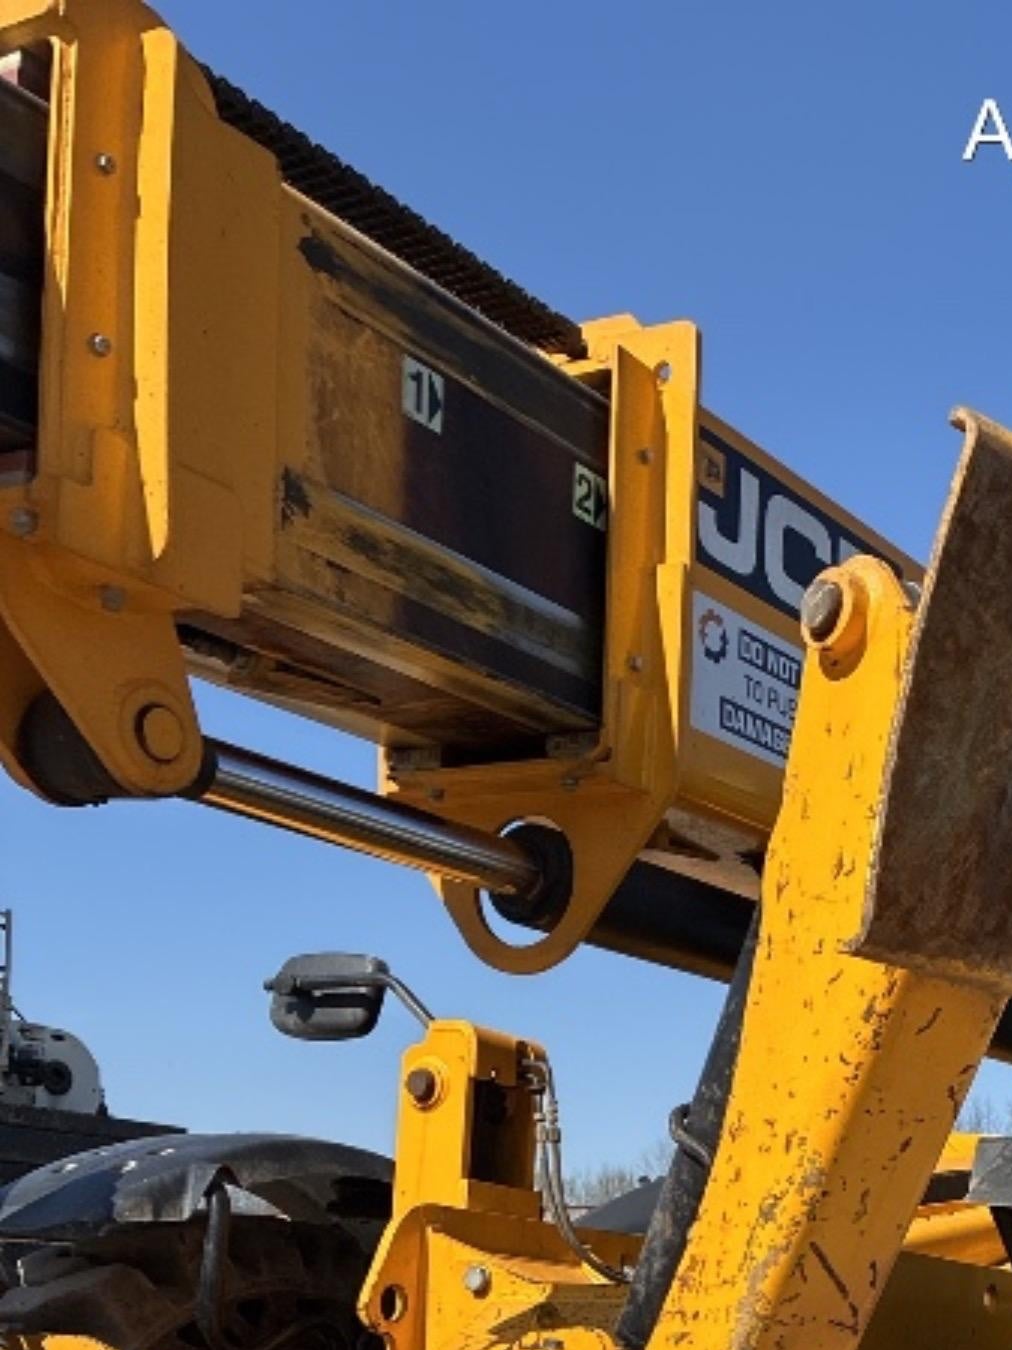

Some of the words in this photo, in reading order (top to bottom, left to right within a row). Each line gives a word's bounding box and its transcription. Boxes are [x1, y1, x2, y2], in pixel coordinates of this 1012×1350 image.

[407, 368, 423, 414] 1
[576, 473, 592, 517] 2
[698, 467, 862, 618] JC
[767, 652, 799, 686] NOT
